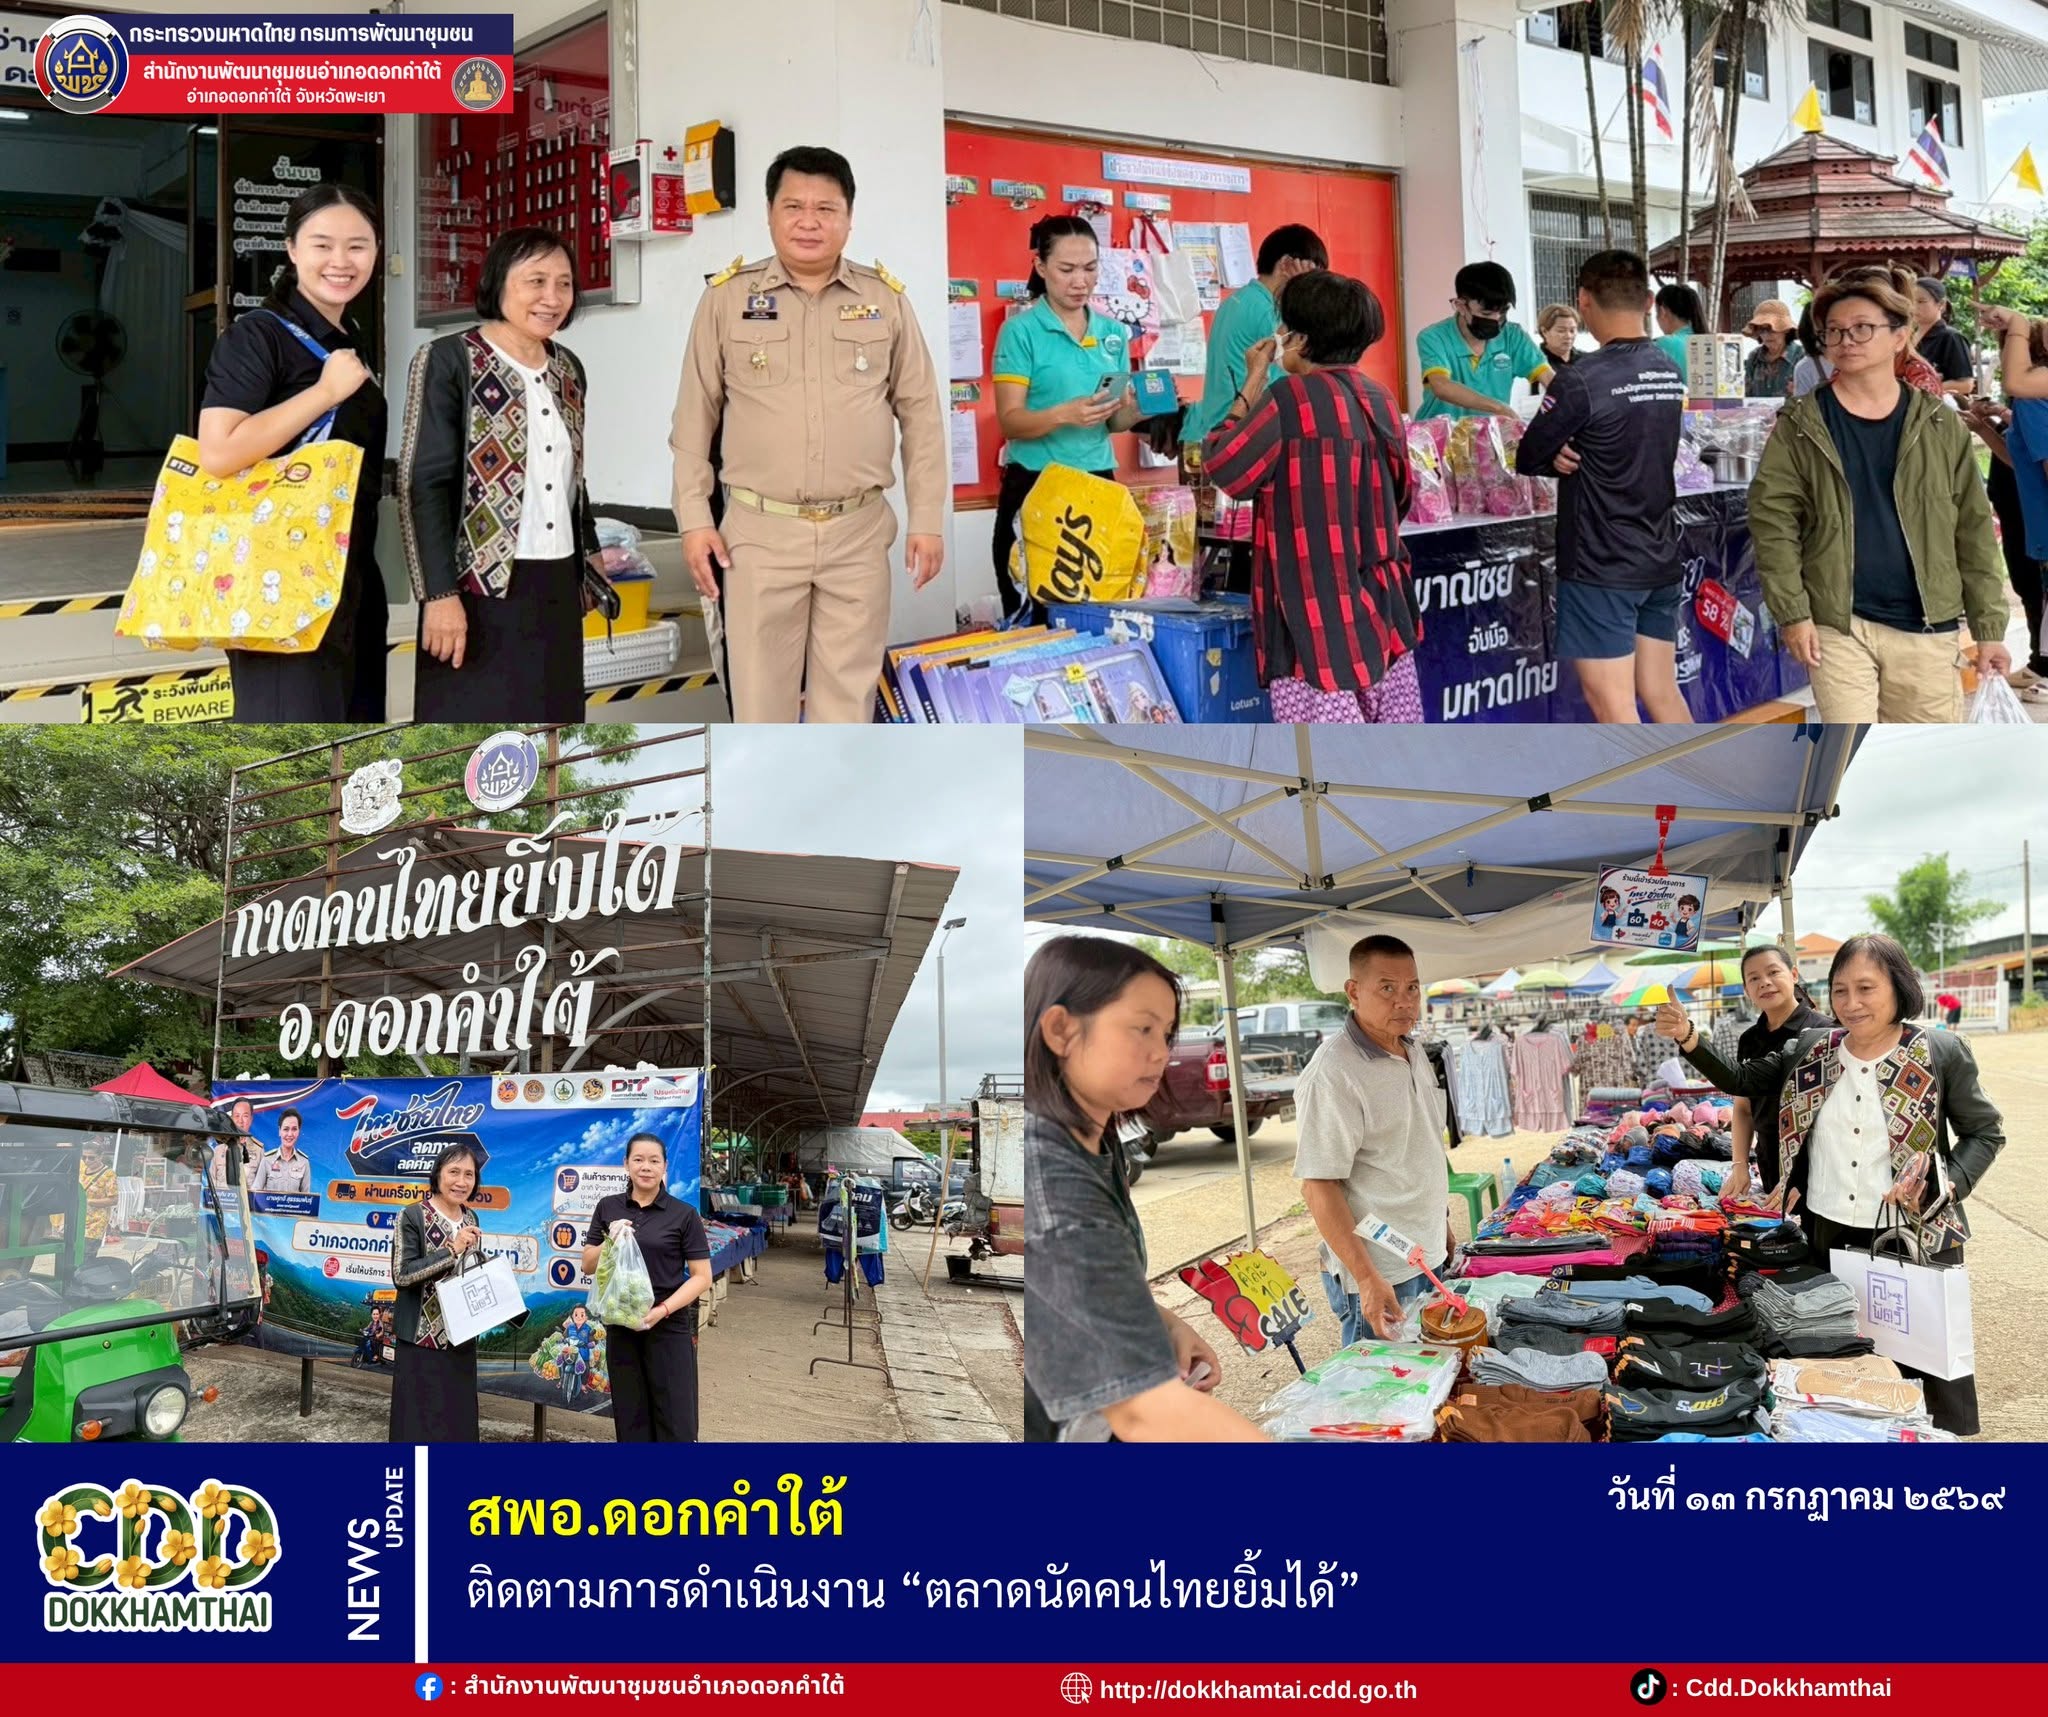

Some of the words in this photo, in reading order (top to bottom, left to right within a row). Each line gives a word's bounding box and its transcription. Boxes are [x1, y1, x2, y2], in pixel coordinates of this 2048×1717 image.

[1702, 599, 1719, 622] 58
[1468, 621, 1509, 654] จับมือ
[1443, 657, 1558, 721] มหาดไทย
[153, 700, 230, 723] BEWARE
[1230, 696, 1261, 712] Lotus's
[1630, 916, 1642, 924] 60
[1651, 919, 1664, 927] 40
[277, 944, 620, 1061] อ.ดอกคำใต้
[1261, 1287, 1309, 1337] SALE
